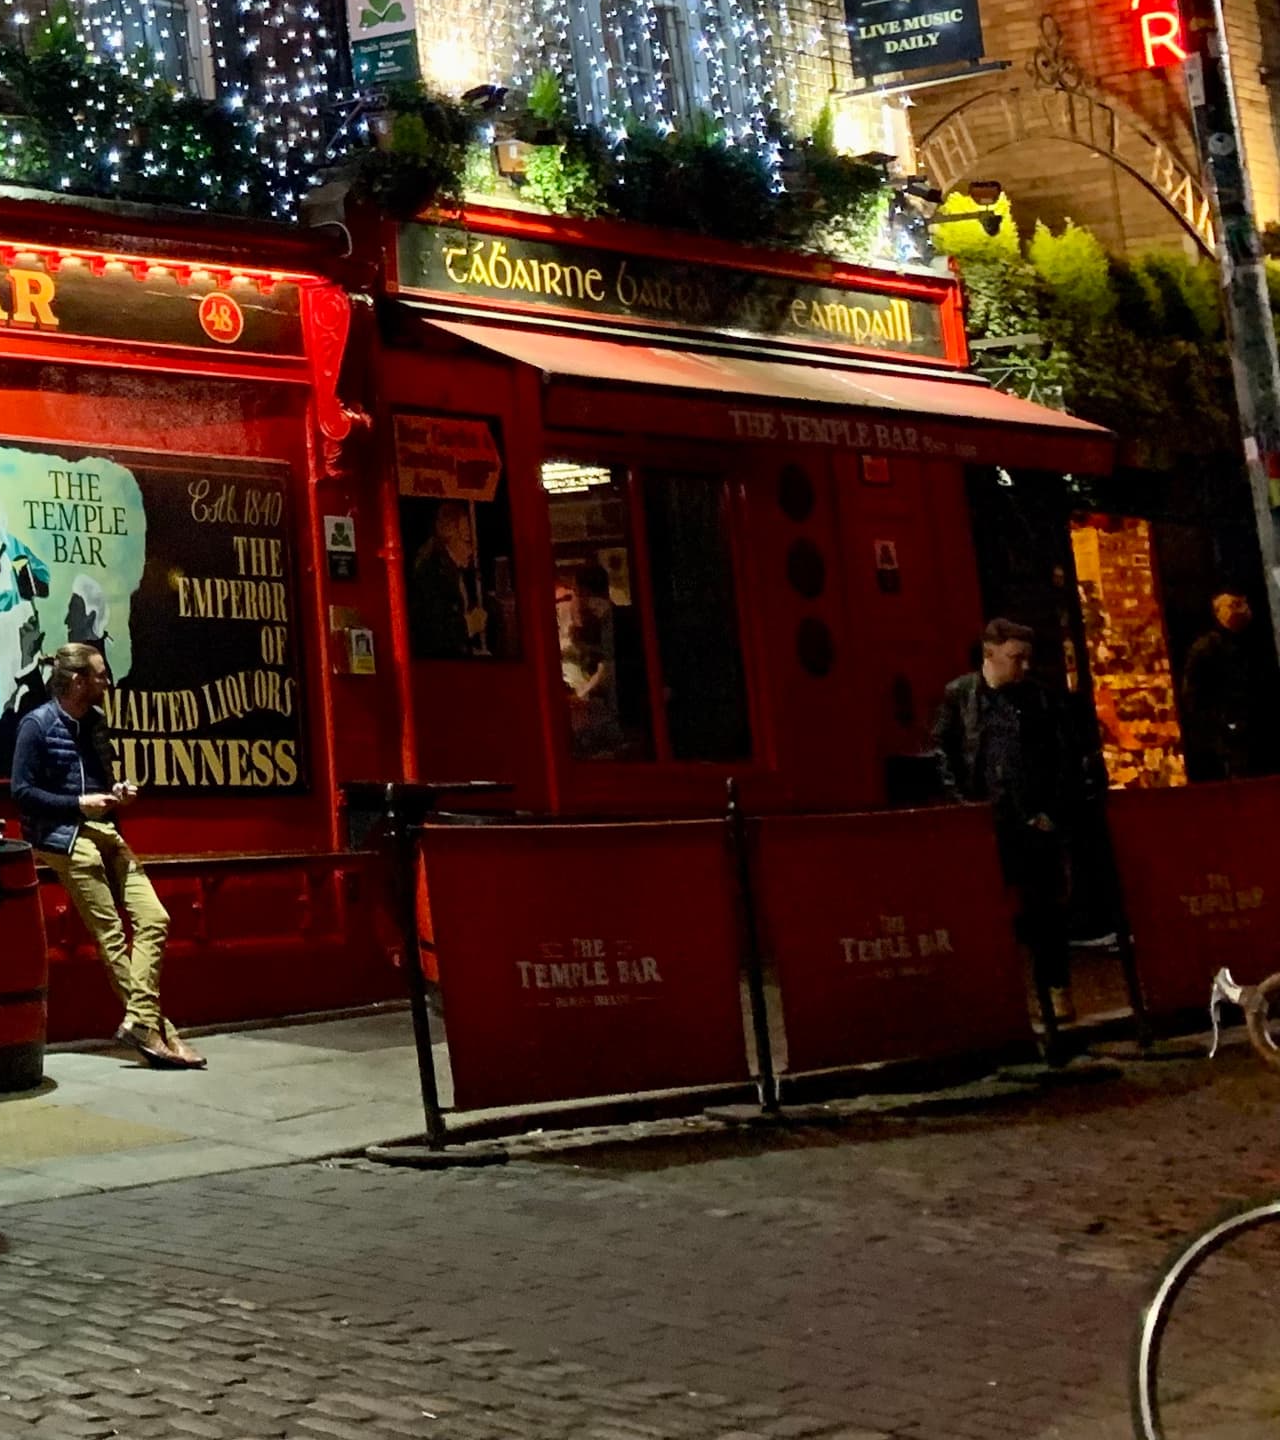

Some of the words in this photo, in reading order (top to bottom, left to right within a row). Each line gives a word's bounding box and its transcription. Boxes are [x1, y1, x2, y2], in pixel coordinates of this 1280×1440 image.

[859, 20, 900, 40] LIVE
[902, 8, 963, 31] MUSIC
[885, 32, 941, 55] DAILY
[206, 300, 236, 335] 48
[728, 409, 778, 440] THE
[780, 413, 872, 448] TEMPLE
[873, 423, 921, 453] BAR
[47, 469, 103, 502] THE
[23, 499, 130, 537] TEMPLE
[242, 486, 284, 528] 1840
[52, 532, 107, 569] BAR
[233, 537, 284, 578] THE
[178, 575, 290, 623] EMPEROR
[261, 626, 289, 666] OF
[103, 687, 200, 733] MALTED
[201, 673, 297, 726] LIQUORS
[570, 936, 607, 959] THE
[514, 959, 610, 990] TEMPLE
[615, 955, 665, 985] BAR
